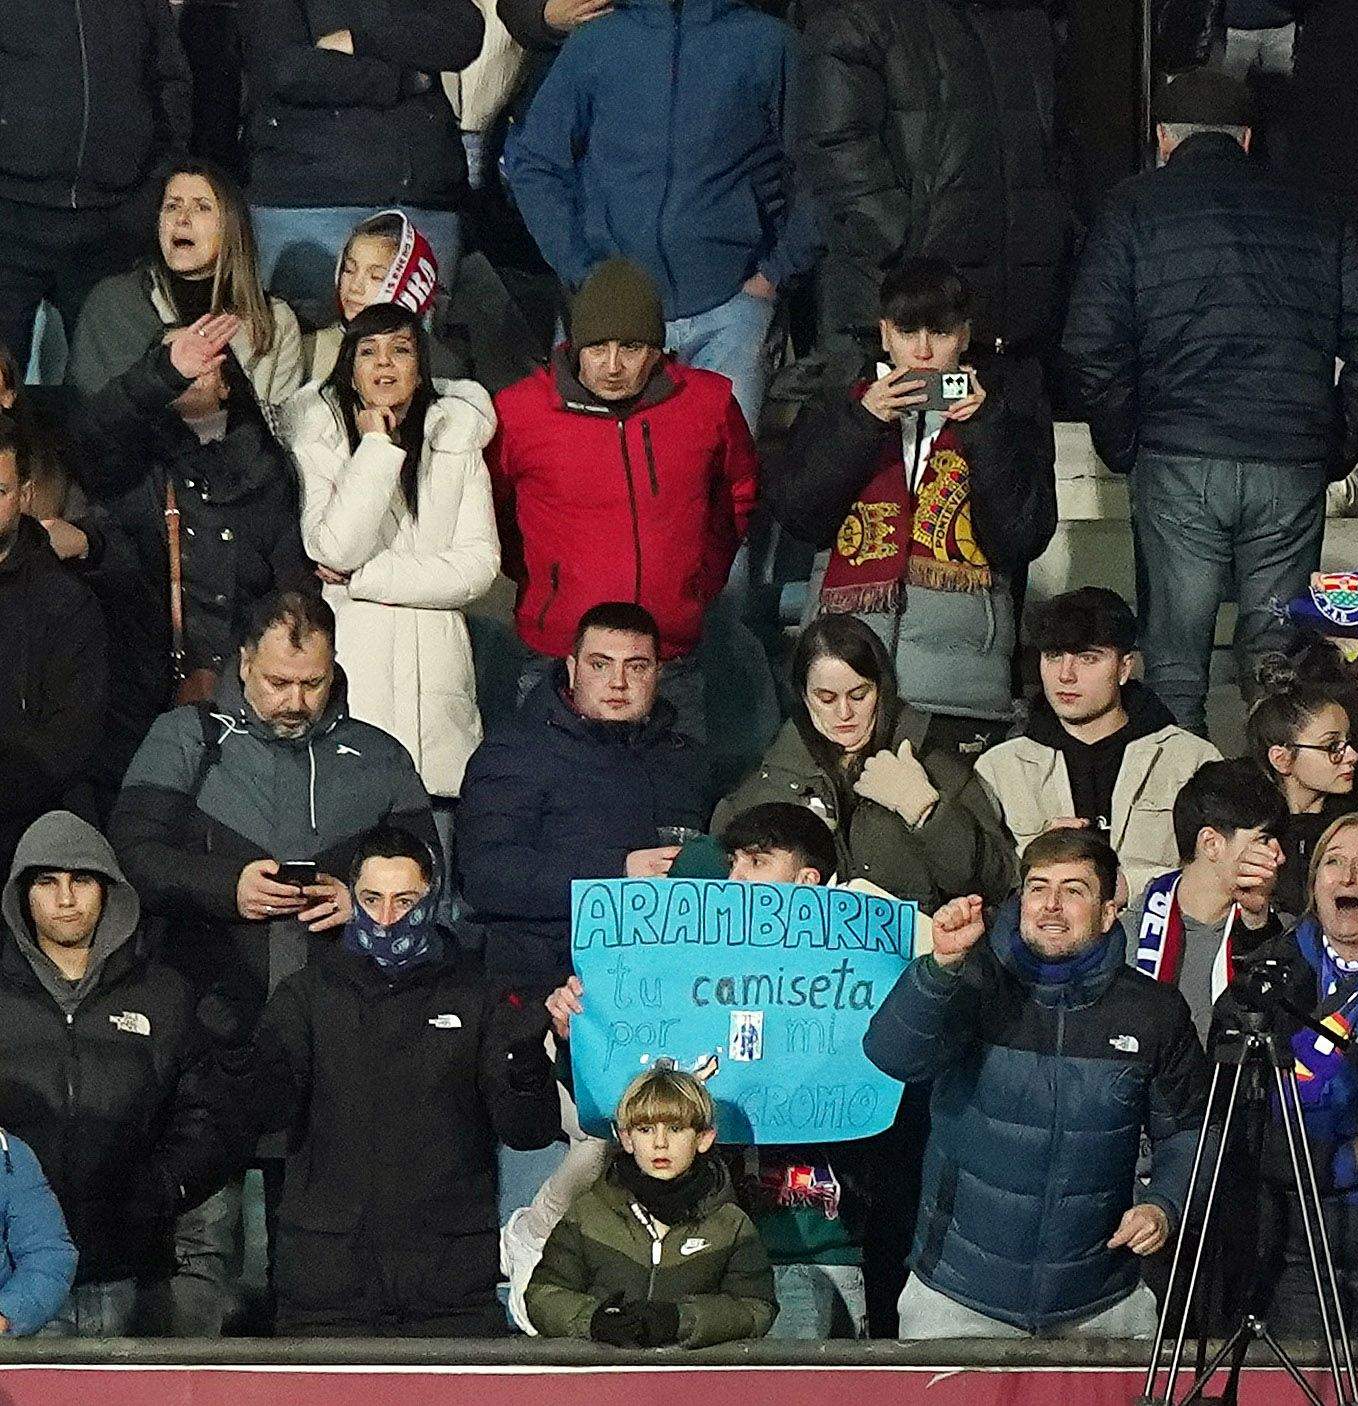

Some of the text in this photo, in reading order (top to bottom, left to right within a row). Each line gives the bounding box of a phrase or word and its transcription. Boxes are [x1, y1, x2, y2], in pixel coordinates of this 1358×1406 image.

[573, 880, 916, 961] ARAMBARRI
[606, 953, 876, 1012] tu camiseta
[602, 1012, 839, 1073] por mi
